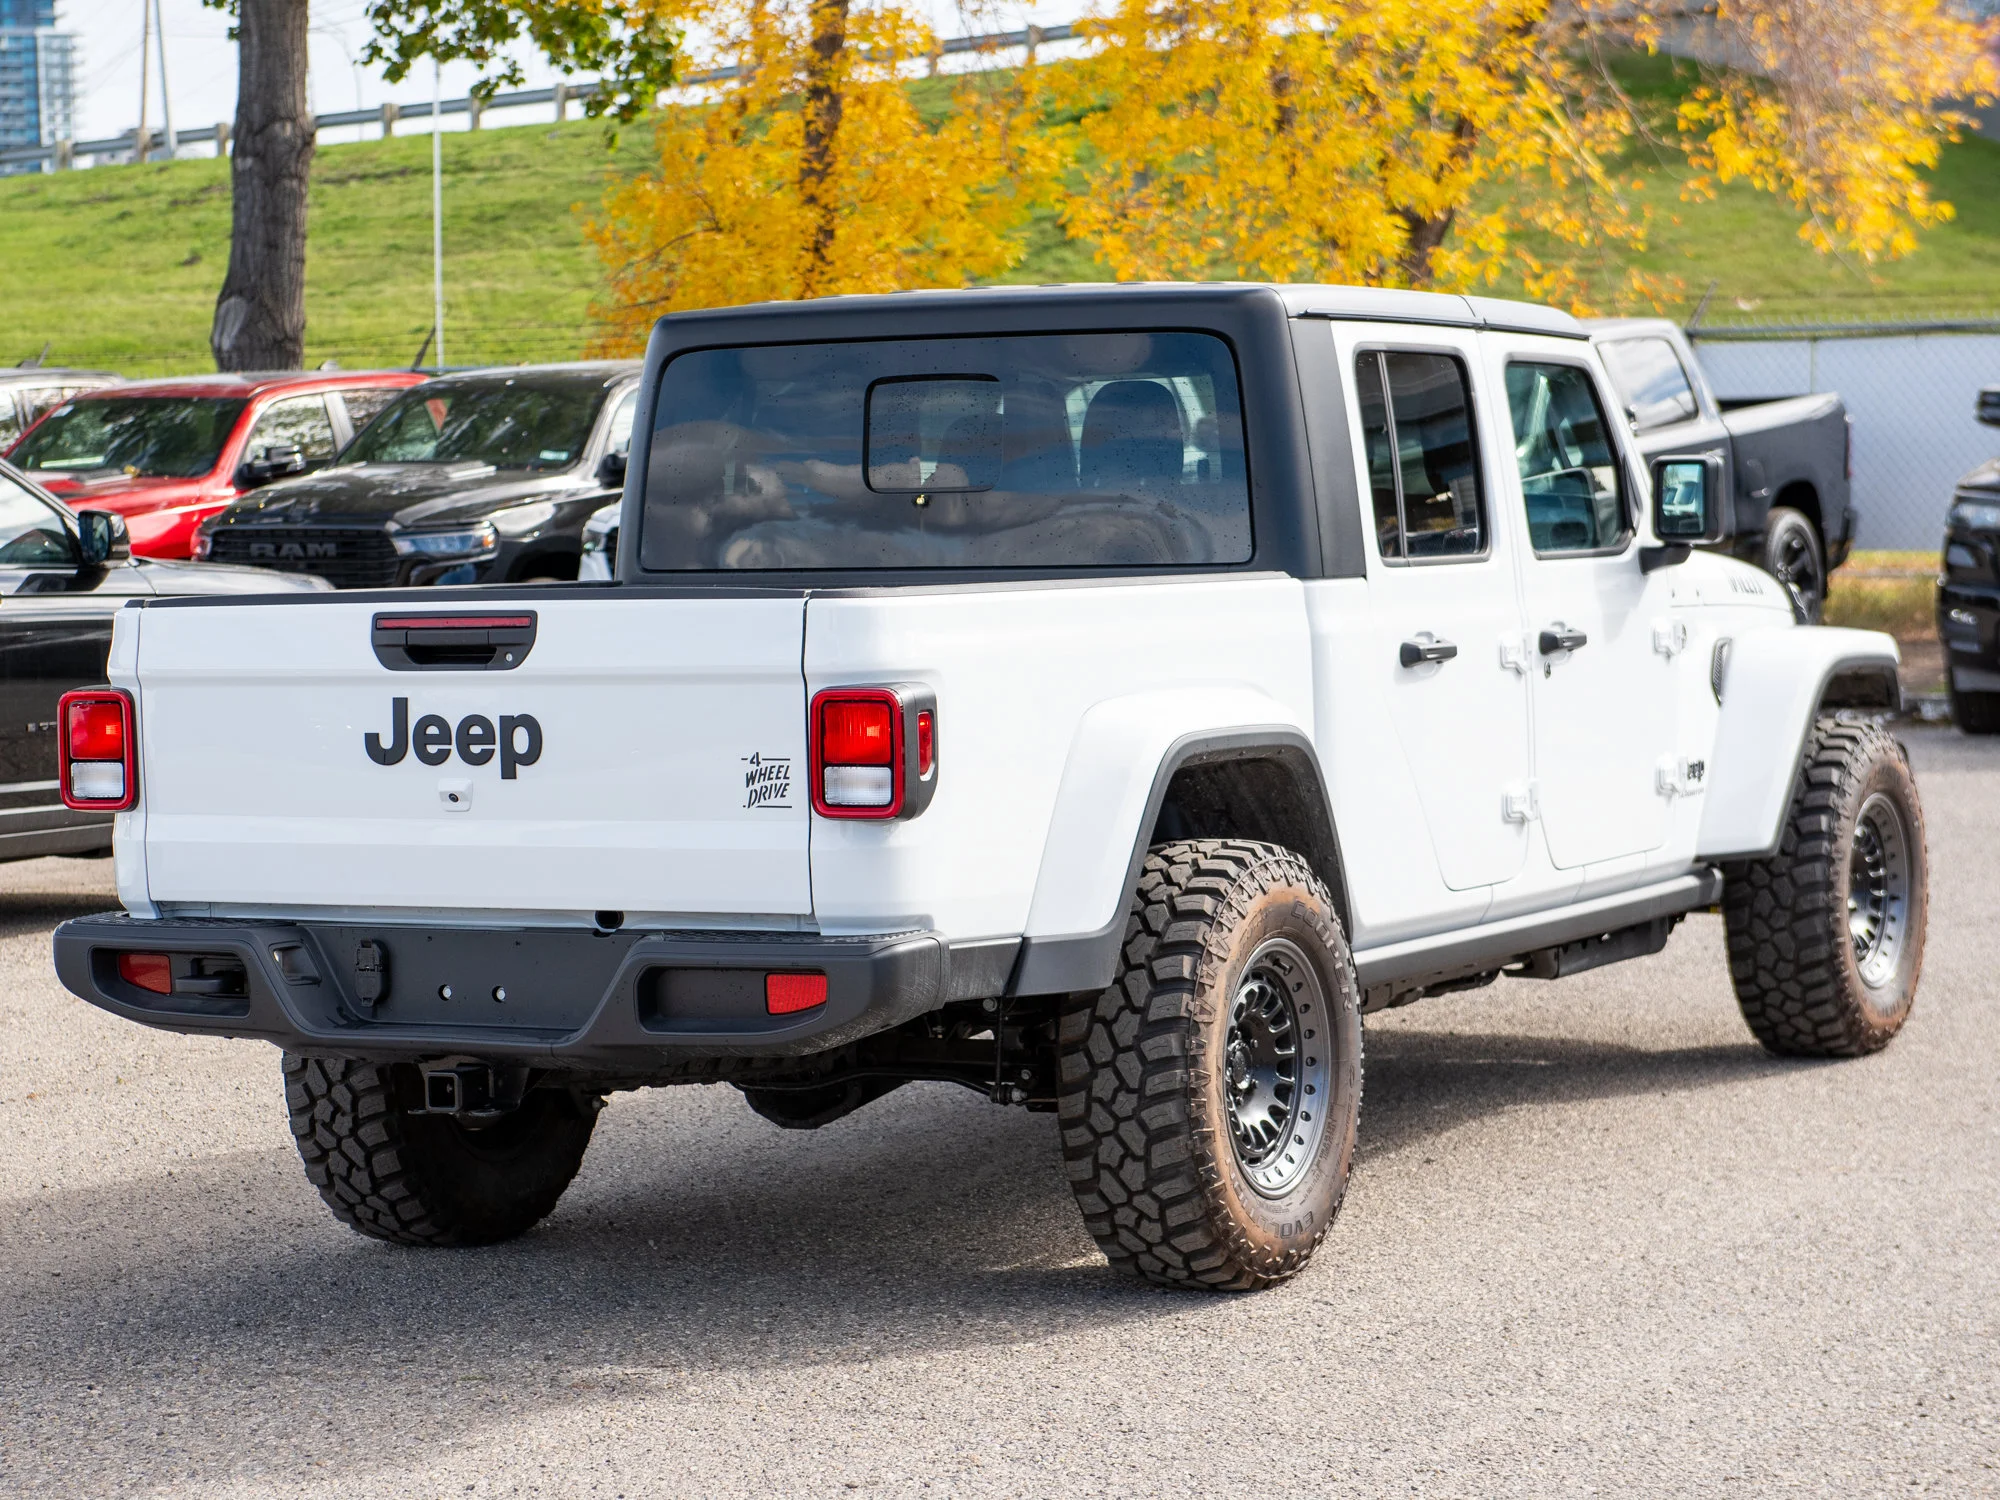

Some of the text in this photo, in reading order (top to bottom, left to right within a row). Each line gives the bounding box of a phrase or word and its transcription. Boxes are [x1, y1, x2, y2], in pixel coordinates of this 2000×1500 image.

[249, 543, 337, 558] RAM
[364, 697, 543, 779] Jeep
[749, 751, 761, 767] 4
[745, 764, 790, 789] WHEEL
[747, 782, 791, 809] DRIVE
[1291, 900, 1352, 1011] COOPER
